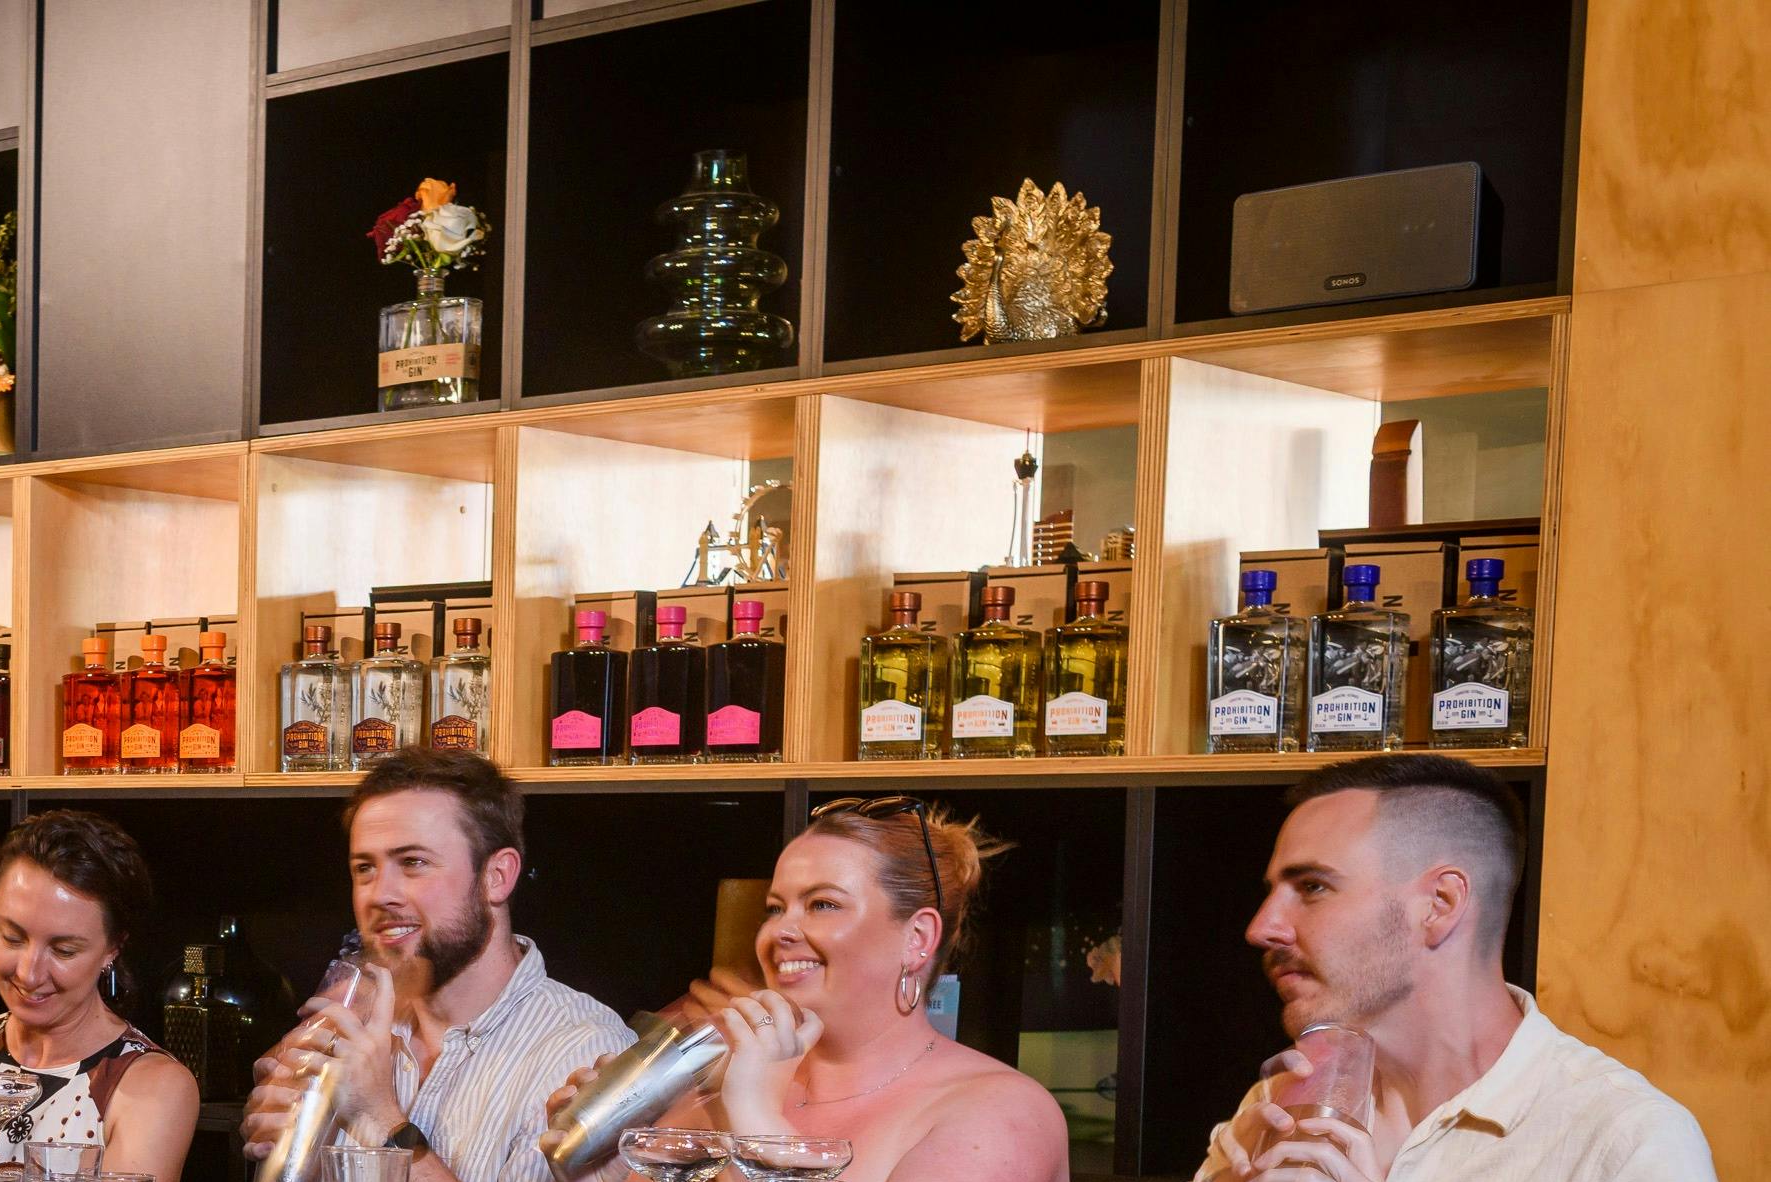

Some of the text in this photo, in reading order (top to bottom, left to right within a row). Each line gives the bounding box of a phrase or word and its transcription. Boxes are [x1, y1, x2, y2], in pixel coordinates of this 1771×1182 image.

[1331, 276, 1360, 287] SONOS
[408, 366, 423, 377] GIN
[1317, 702, 1376, 714] PROHIBITION
[1439, 698, 1502, 711] PROHIBITION
[1215, 705, 1271, 717] PROHIBITION
[1461, 709, 1476, 718] GIN
[866, 713, 916, 725] PROHIBITION
[1234, 716, 1248, 725] GIN
[1337, 713, 1352, 721] GIN
[286, 731, 324, 741] PROHIBITION
[355, 729, 392, 739] PROHIBITION
[435, 727, 474, 737] PROHIBITION
